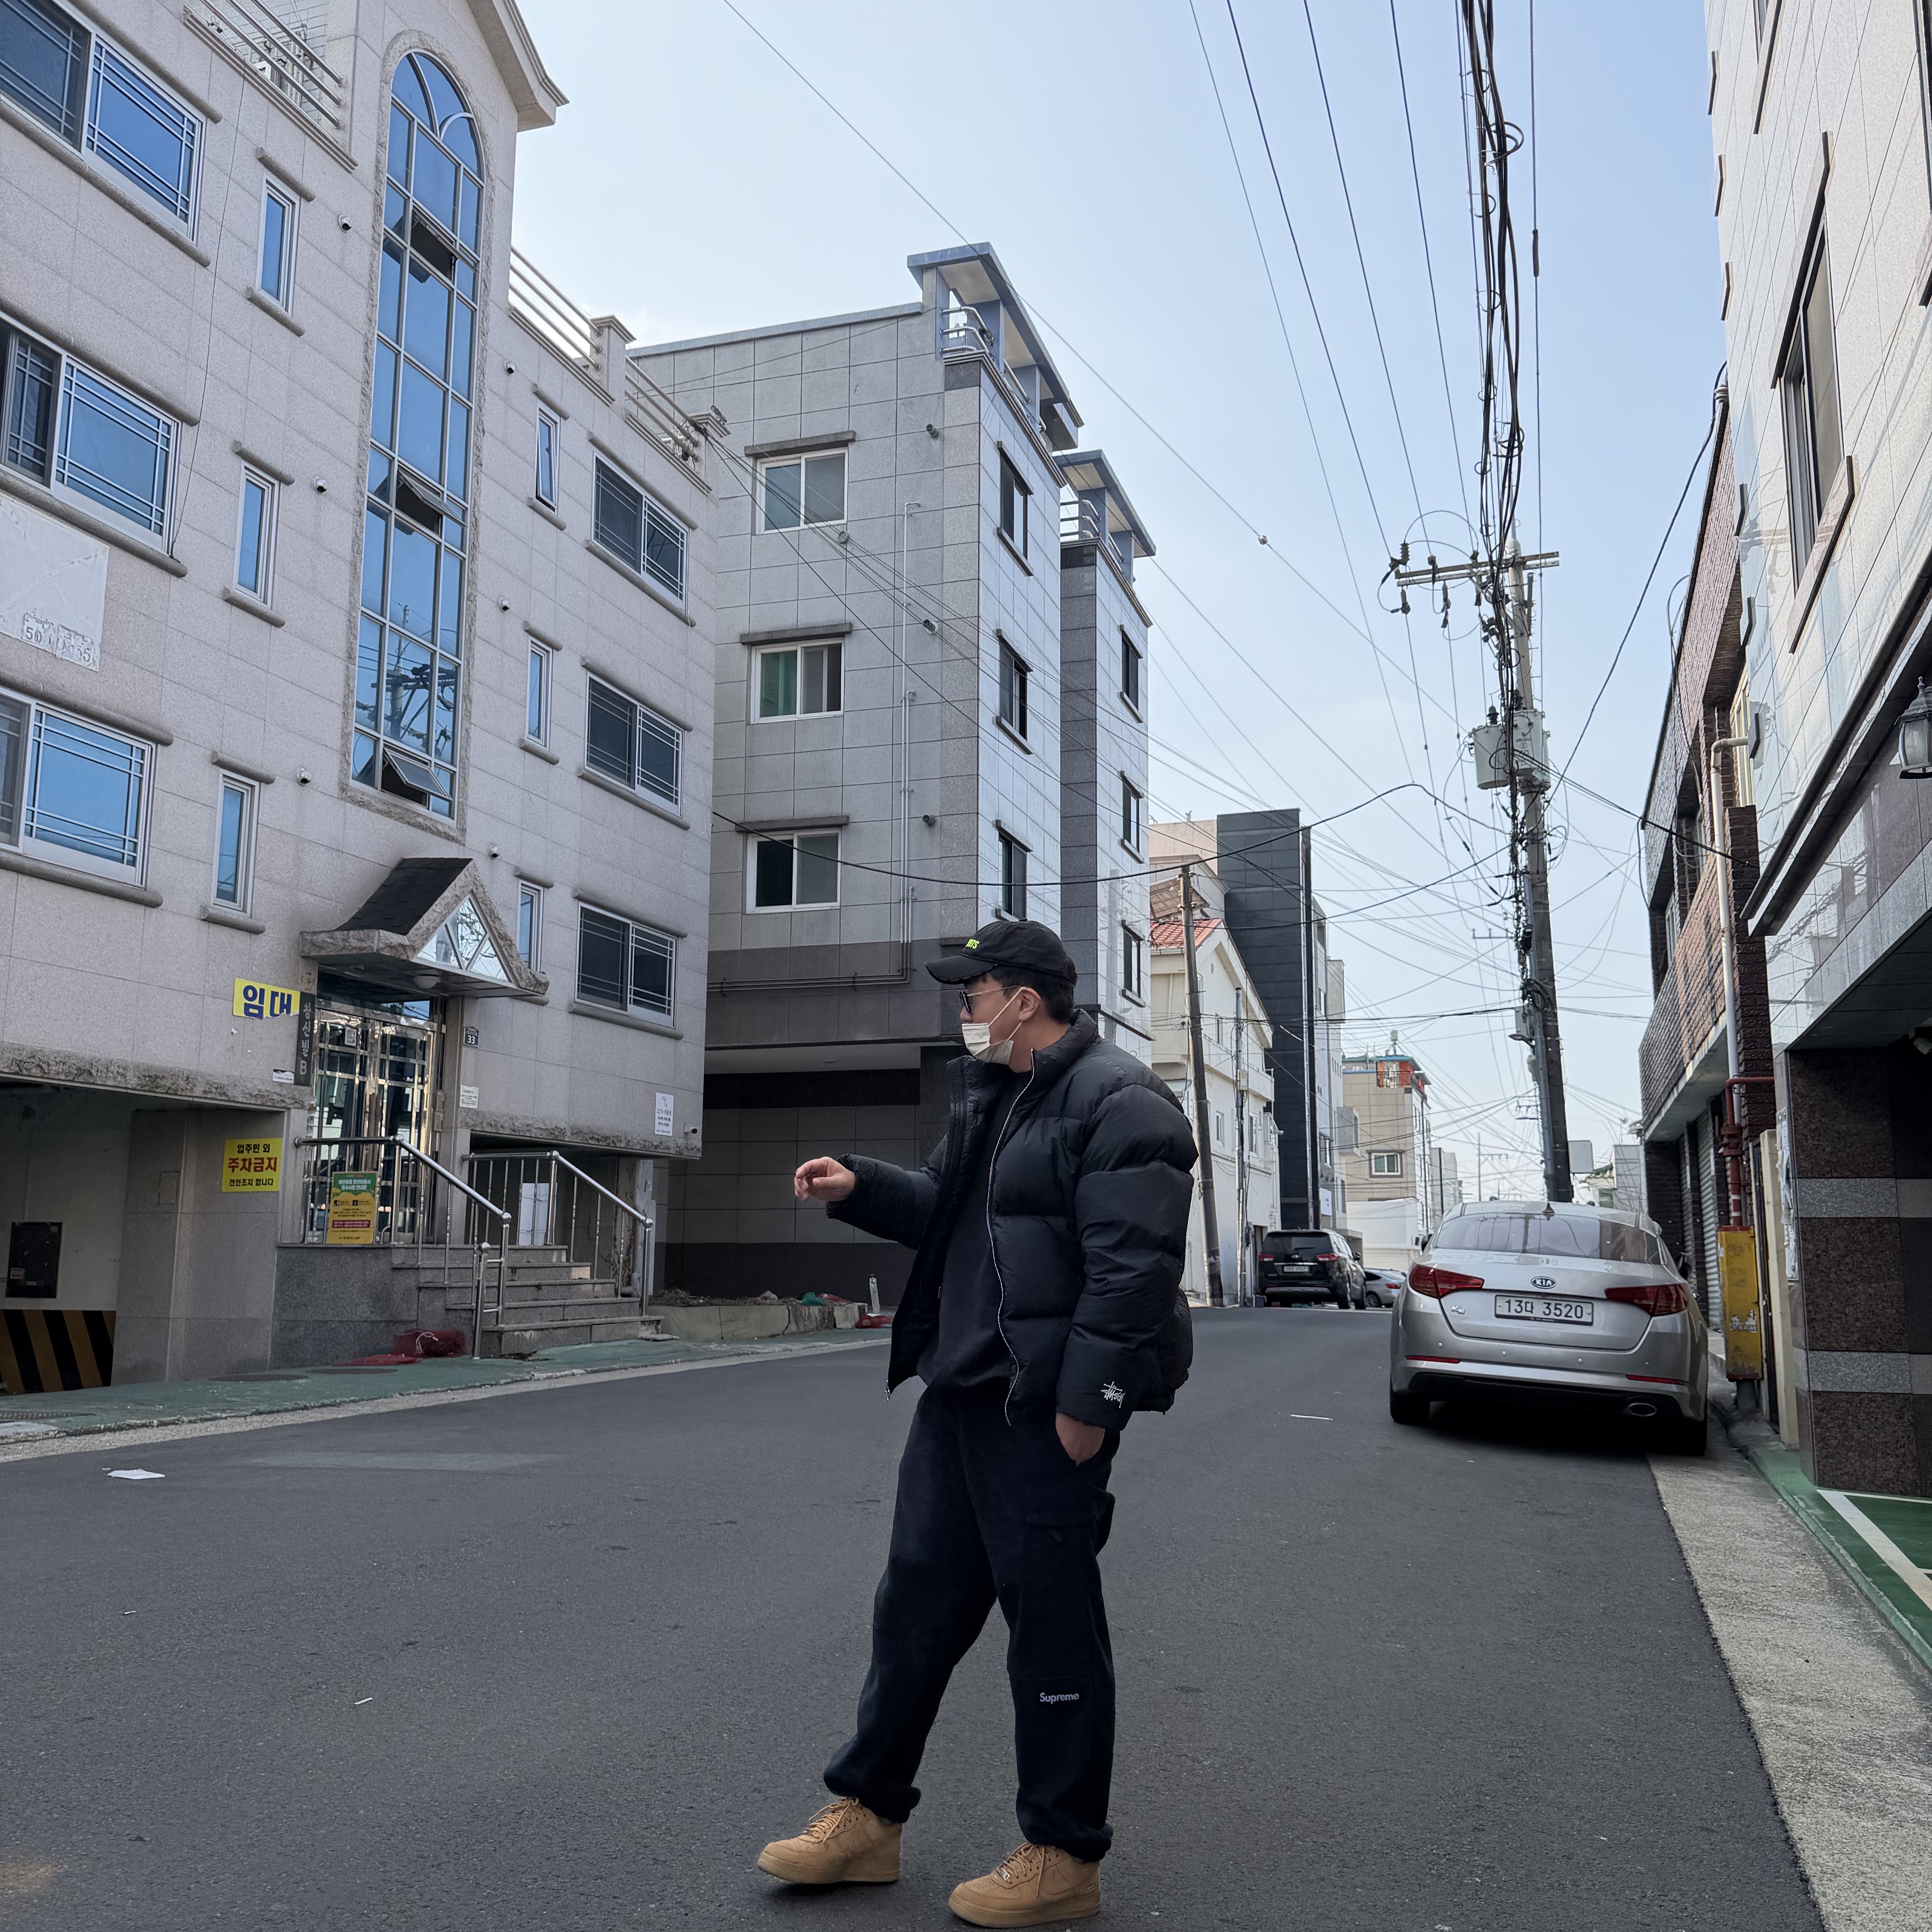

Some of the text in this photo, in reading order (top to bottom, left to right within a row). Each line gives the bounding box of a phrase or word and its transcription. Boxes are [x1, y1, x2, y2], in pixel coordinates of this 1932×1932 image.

[243, 985, 292, 1020] 임대
[467, 1035, 475, 1044] 33
[237, 1143, 270, 1154] 입주민 외
[228, 1157, 277, 1173] 주차금지
[1542, 1302, 1583, 1319] 3520
[1040, 1692, 1080, 1704] Supreme
